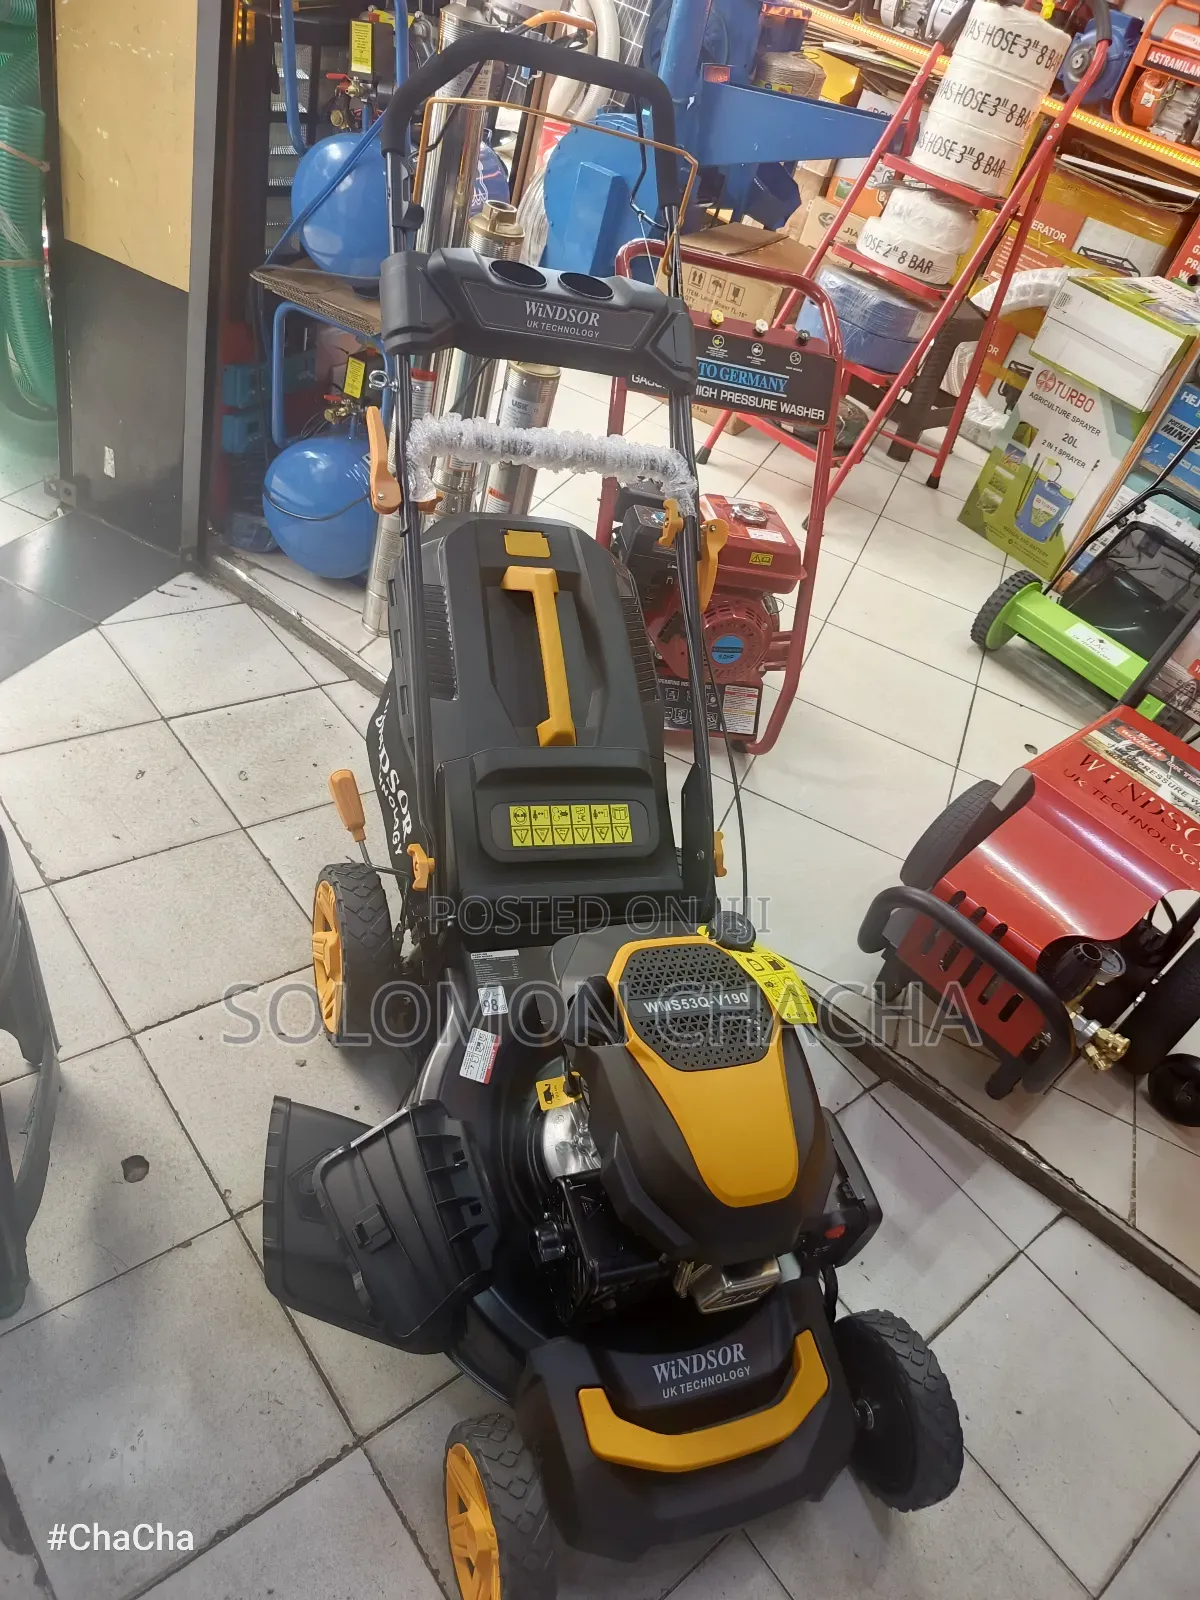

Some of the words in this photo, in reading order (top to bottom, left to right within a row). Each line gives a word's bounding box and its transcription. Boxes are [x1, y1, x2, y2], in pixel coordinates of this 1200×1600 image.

[982, 23, 1022, 55] HOSE
[1036, 45, 1049, 66] 8
[954, 83, 992, 114] HOSE
[1005, 104, 1018, 124] 8
[924, 132, 959, 161] HOSE
[972, 152, 985, 171] 8
[983, 151, 1006, 179] BAR
[898, 250, 908, 265] 8
[908, 254, 934, 275] BAR
[526, 319, 539, 329] UK
[541, 322, 600, 338] TECHNOLOGY
[719, 363, 788, 393] GERMANY
[511, 399, 528, 411] USK
[720, 389, 777, 412] PRESSURE
[780, 402, 825, 421] WASHER
[1054, 380, 1095, 413] TURBO
[1029, 391, 1072, 420] AGRICULTURE
[1071, 415, 1101, 437] SPRAYER
[1046, 442, 1054, 450] IN
[1057, 448, 1087, 469] SPRAYER
[1061, 433, 1079, 449] 20L
[1063, 768, 1087, 788] UK
[1136, 761, 1189, 798] PRESSURE
[483, 999, 499, 1013] 98
[643, 991, 749, 1014] WMS53Q-V190
[662, 1386, 678, 1399] UK
[680, 1366, 751, 1395] TECHNOLOGY
